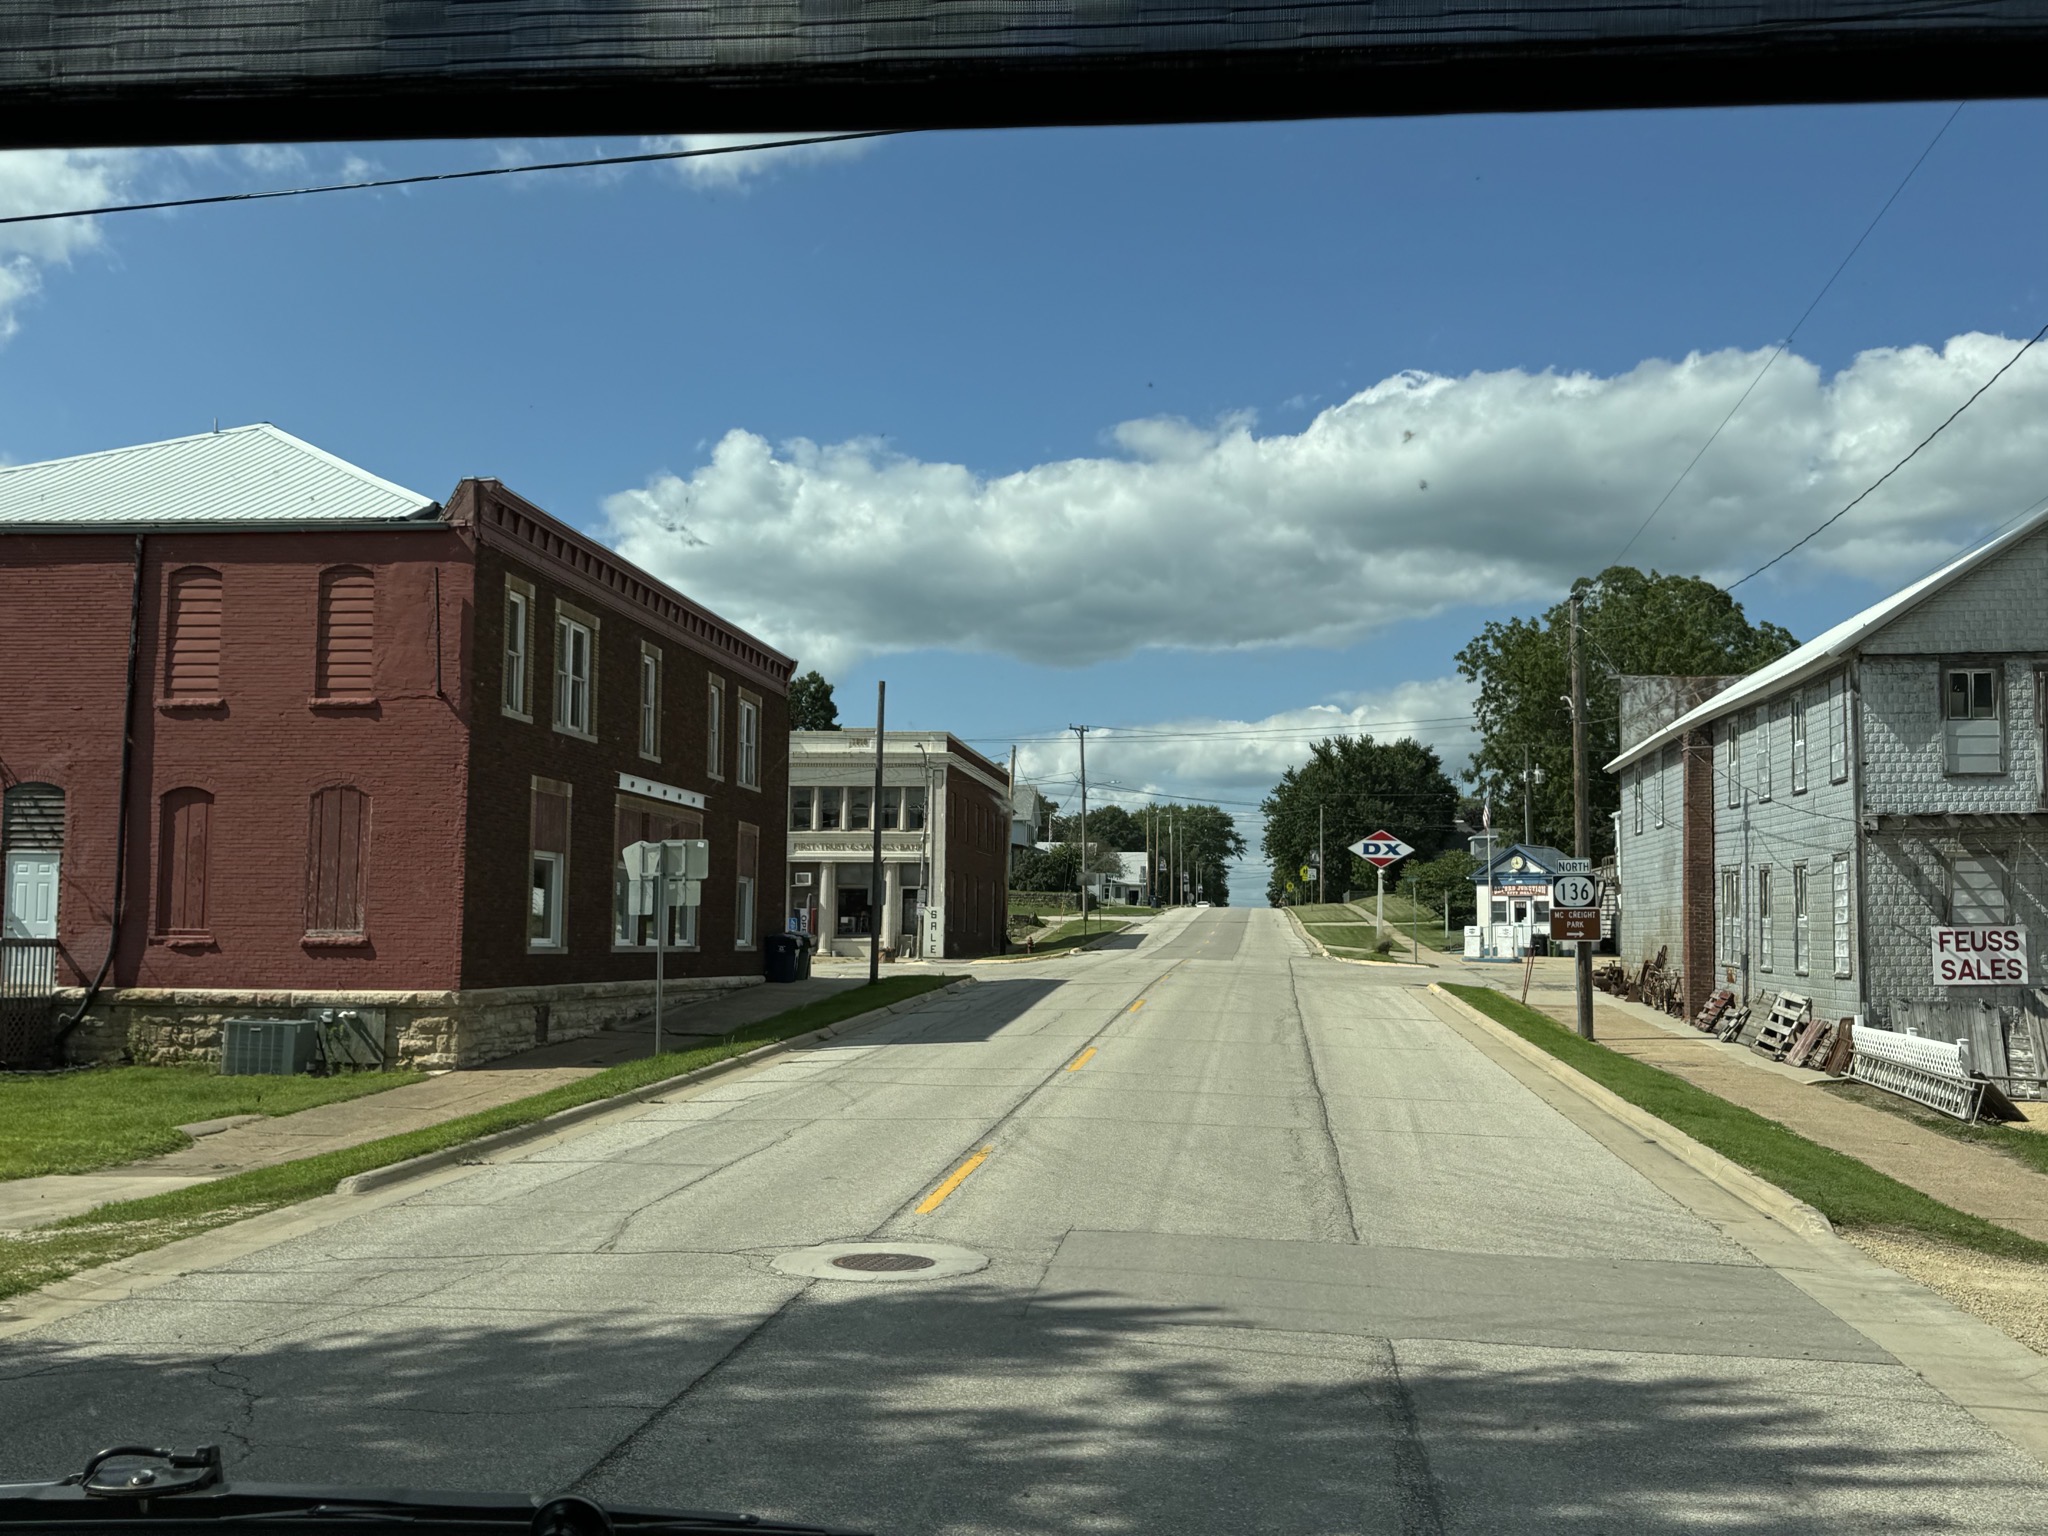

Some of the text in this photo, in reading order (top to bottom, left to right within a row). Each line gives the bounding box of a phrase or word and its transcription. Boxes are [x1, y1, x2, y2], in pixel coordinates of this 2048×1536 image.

[794, 843, 816, 851] FIRST
[820, 843, 846, 851] TRUST
[1362, 843, 1402, 855] DX
[1558, 862, 1589, 872] NORTH
[1561, 883, 1589, 900] 136
[1939, 930, 2019, 952] FEUSS
[1941, 959, 2022, 980] SALES
